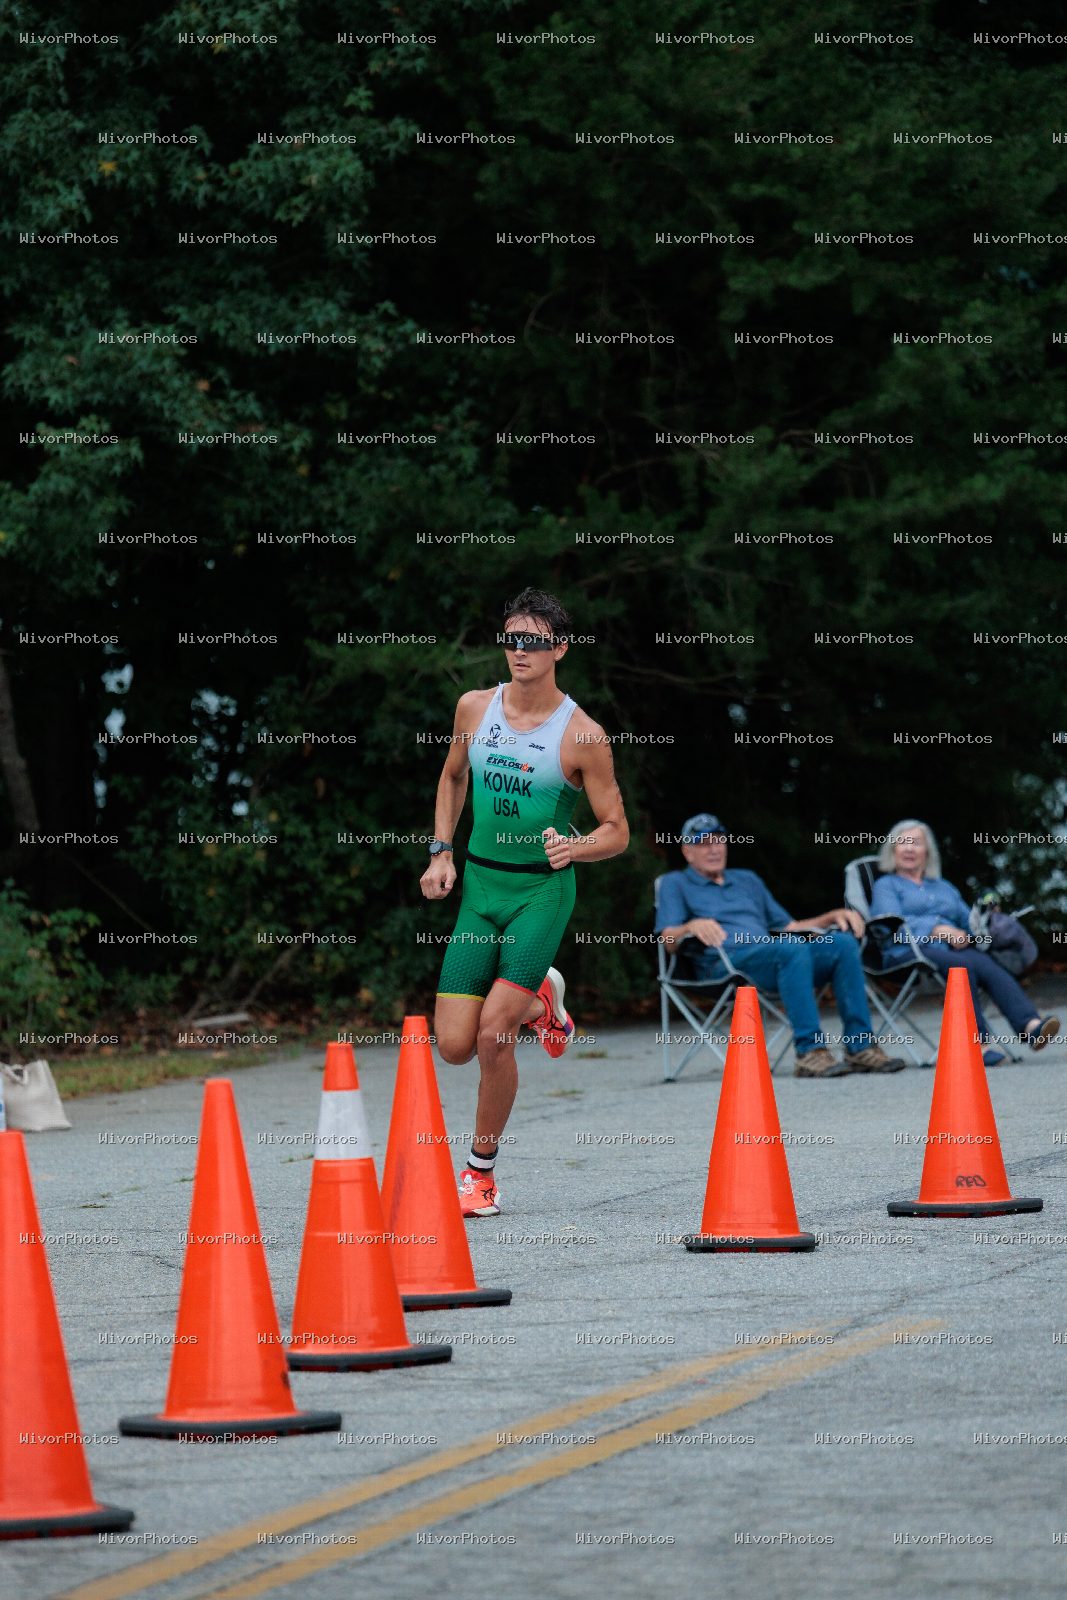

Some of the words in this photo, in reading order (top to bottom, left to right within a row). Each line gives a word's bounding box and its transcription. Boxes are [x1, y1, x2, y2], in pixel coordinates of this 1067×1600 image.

[486, 756, 535, 773] EXPLOSION
[483, 770, 533, 798] KOVAK
[493, 796, 521, 819] USA
